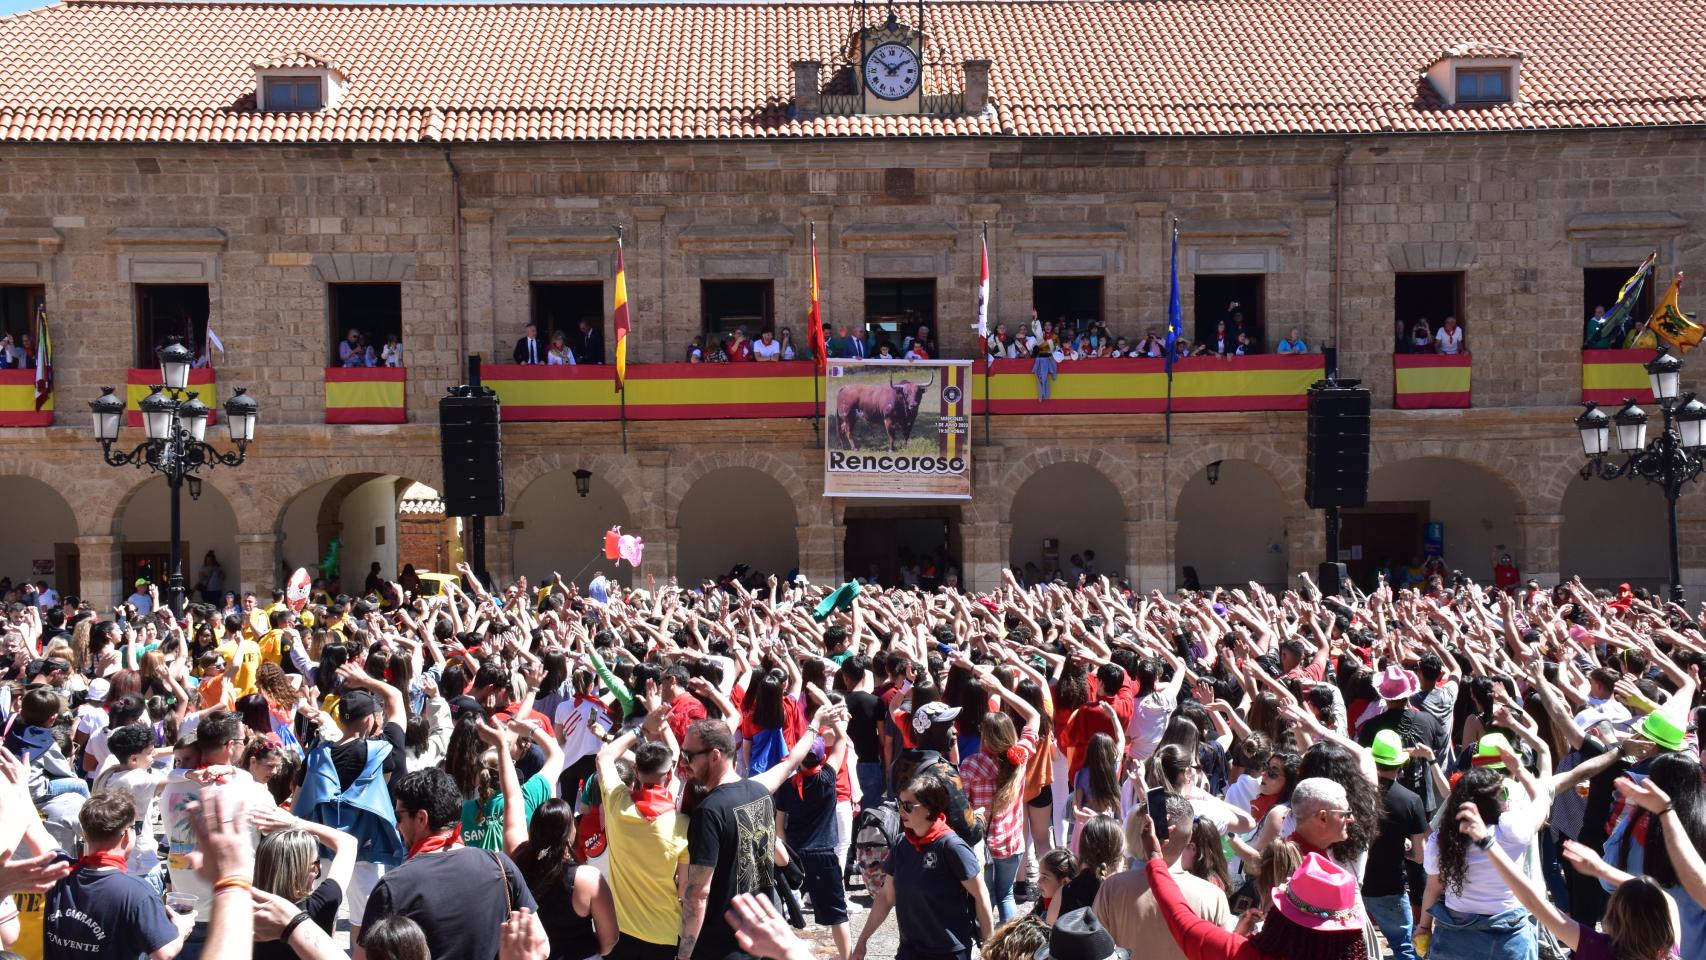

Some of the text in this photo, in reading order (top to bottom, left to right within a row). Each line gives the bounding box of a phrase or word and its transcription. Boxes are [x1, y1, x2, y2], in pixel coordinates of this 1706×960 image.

[829, 451, 965, 472] Rencoroso
[464, 829, 485, 842] SAN
[65, 908, 106, 941] GARRAFON
